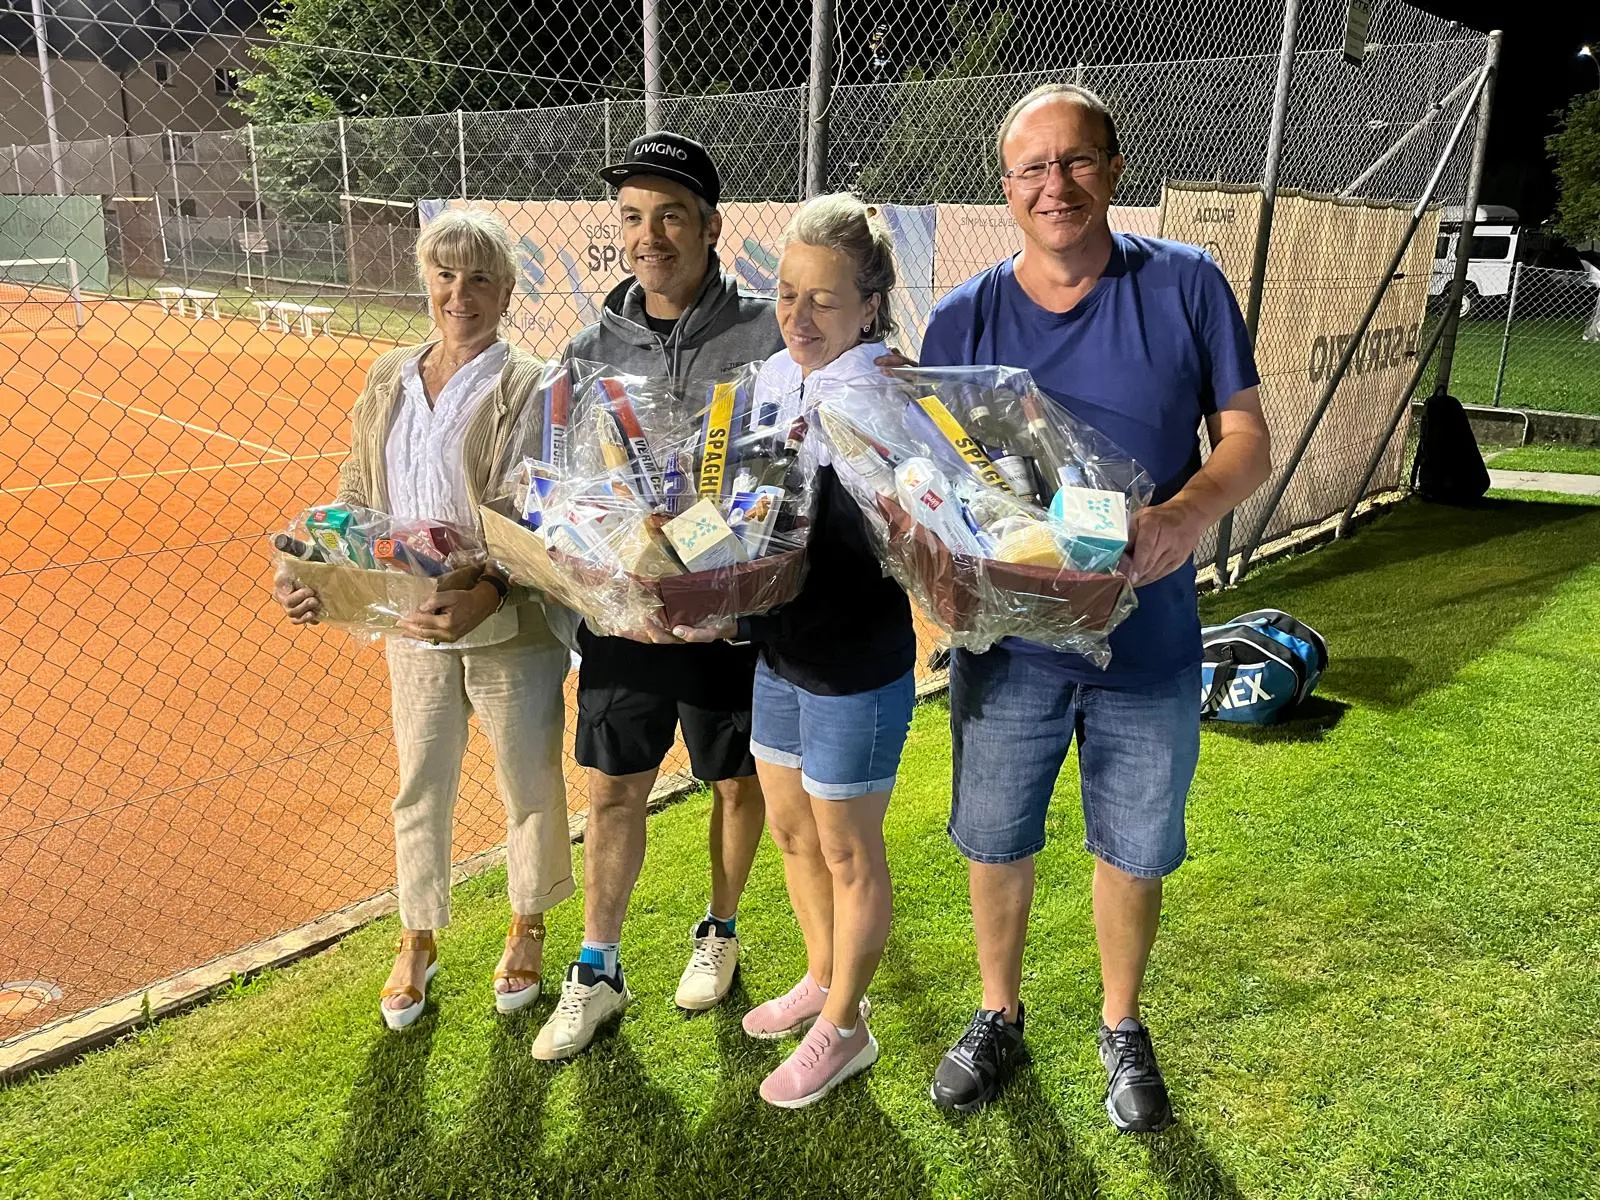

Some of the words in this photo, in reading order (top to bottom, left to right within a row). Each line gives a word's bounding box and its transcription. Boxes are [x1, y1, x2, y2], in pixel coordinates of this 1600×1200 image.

[634, 142, 688, 161] LIVIGNO
[960, 217, 988, 227] SIMPLY
[1201, 672, 1272, 713] NEX
